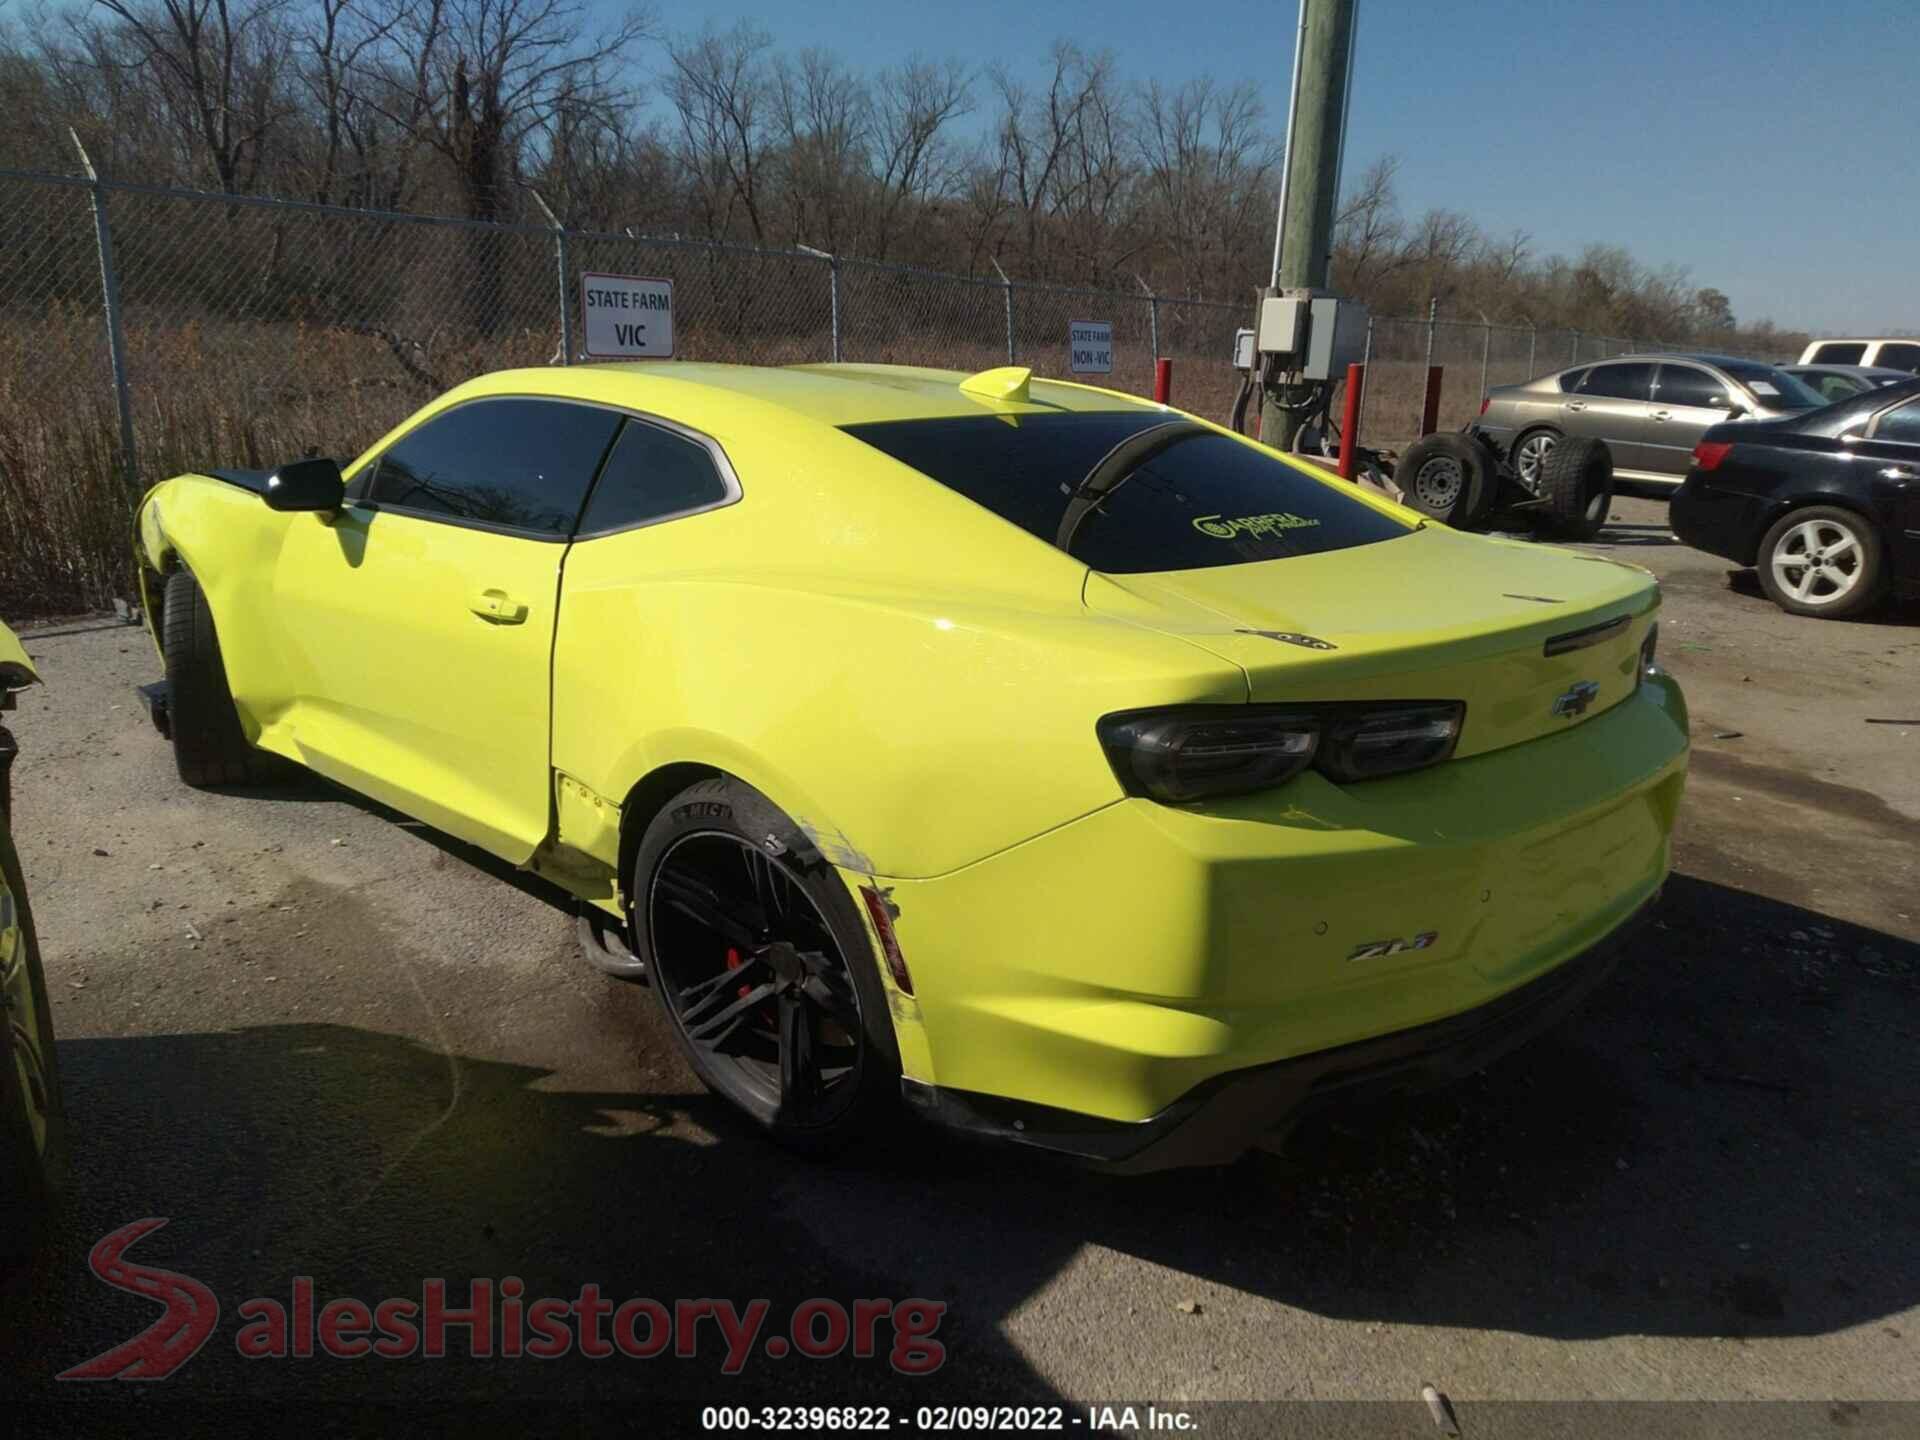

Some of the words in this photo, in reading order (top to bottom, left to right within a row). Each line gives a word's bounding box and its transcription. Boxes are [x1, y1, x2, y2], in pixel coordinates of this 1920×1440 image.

[587, 290, 629, 308] STATE
[632, 292, 670, 311] FARM
[614, 324, 646, 347] VIC
[1072, 329, 1091, 342] STATE
[1073, 350, 1110, 365] NON-VIC
